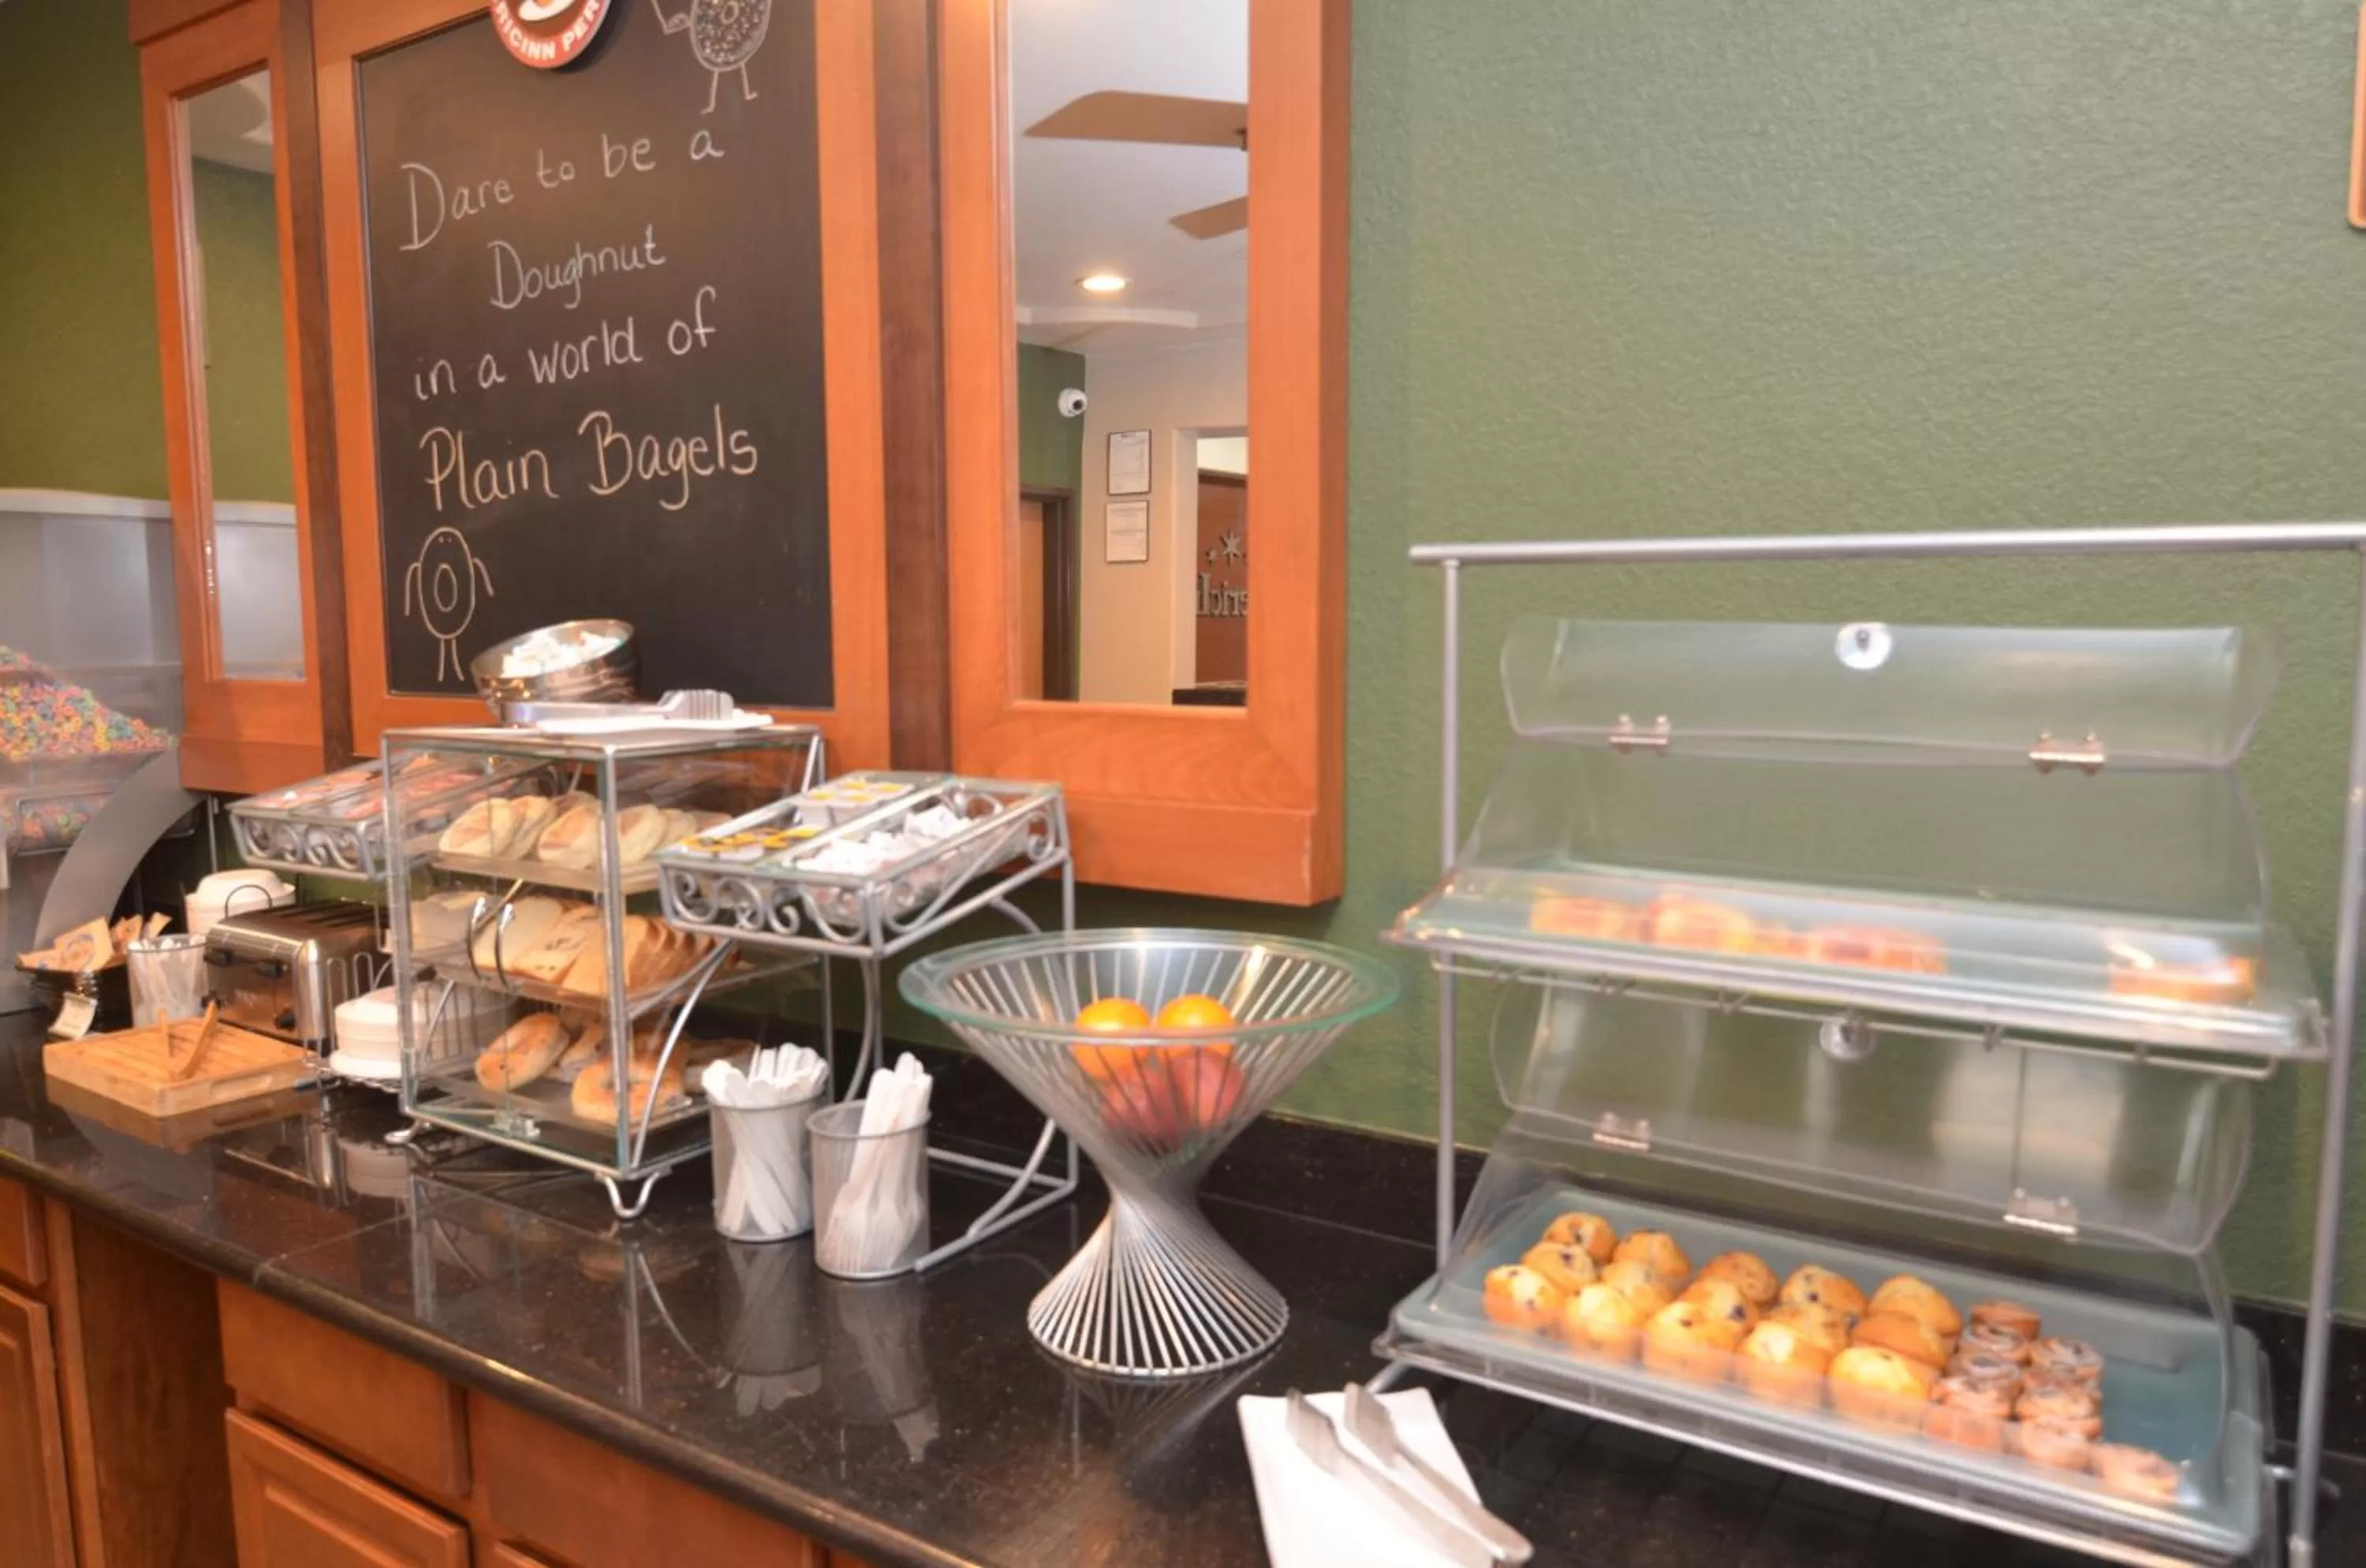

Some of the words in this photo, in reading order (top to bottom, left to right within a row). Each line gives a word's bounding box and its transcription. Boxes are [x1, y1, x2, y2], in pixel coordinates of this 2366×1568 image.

[493, 0, 555, 60] RICINN
[400, 162, 515, 252] Dare
[536, 149, 576, 189] to
[602, 133, 657, 178] be
[689, 129, 725, 160] a
[487, 223, 666, 310] Doughnut
[414, 357, 457, 401] in
[477, 353, 506, 390] a
[527, 315, 644, 384] world
[666, 285, 717, 357] of
[419, 425, 560, 512] Plain
[577, 403, 758, 511] Bagels
